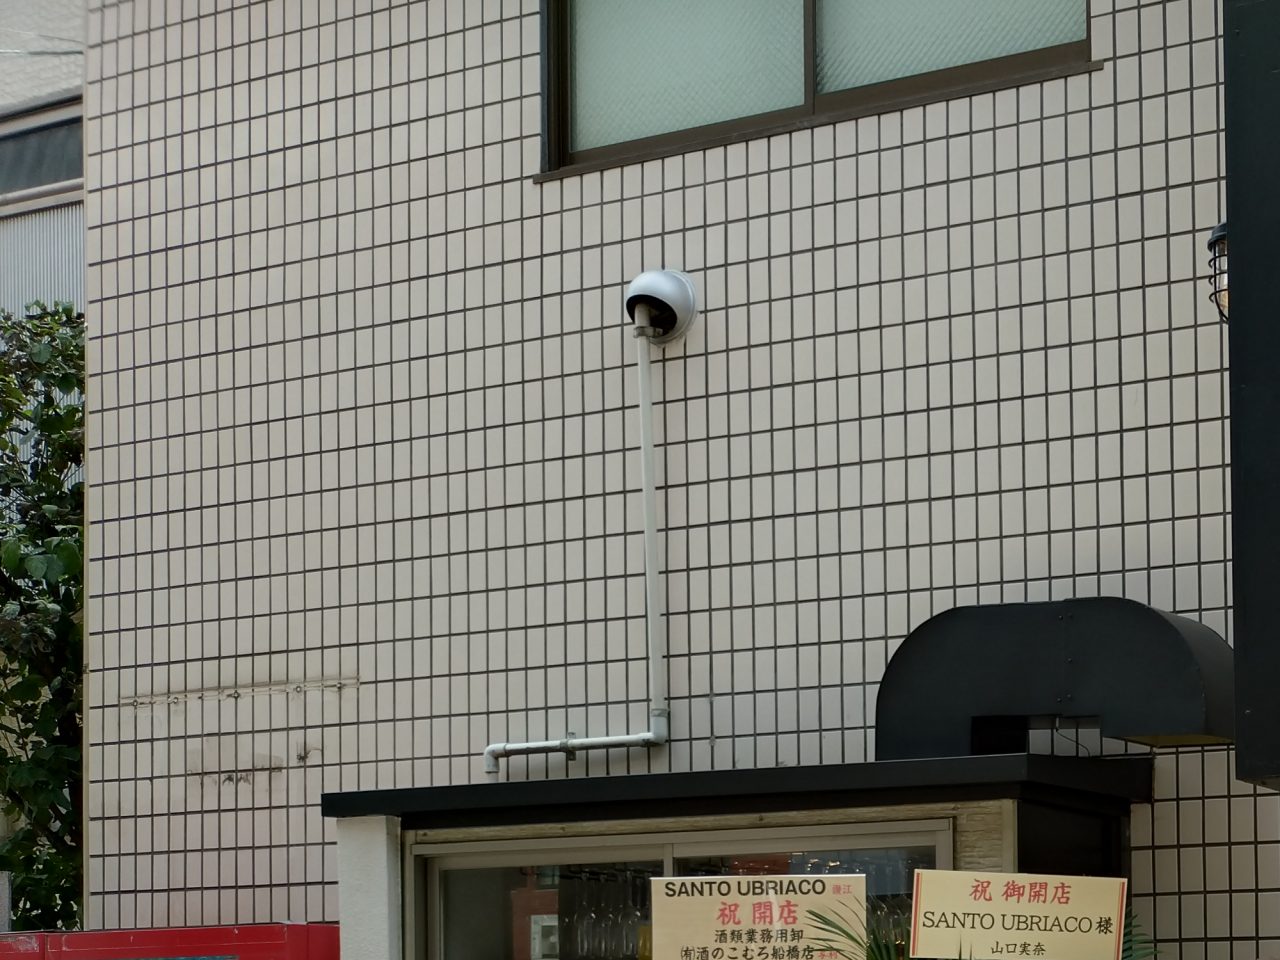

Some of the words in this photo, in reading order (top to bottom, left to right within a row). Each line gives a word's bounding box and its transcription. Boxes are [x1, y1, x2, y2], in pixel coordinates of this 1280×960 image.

[665, 880, 731, 898] SANTO
[738, 879, 826, 896] UBRIACO
[969, 878, 993, 902] 祝
[1001, 880, 1072, 905] 御開店
[717, 901, 743, 926] 祝
[752, 899, 800, 926] 開店
[922, 910, 995, 930] SANTO
[1000, 913, 1093, 934] UBRIACO
[1095, 916, 1114, 935] 様
[714, 928, 804, 944] 酒類業務用卸
[990, 940, 1046, 956] 山口実奈
